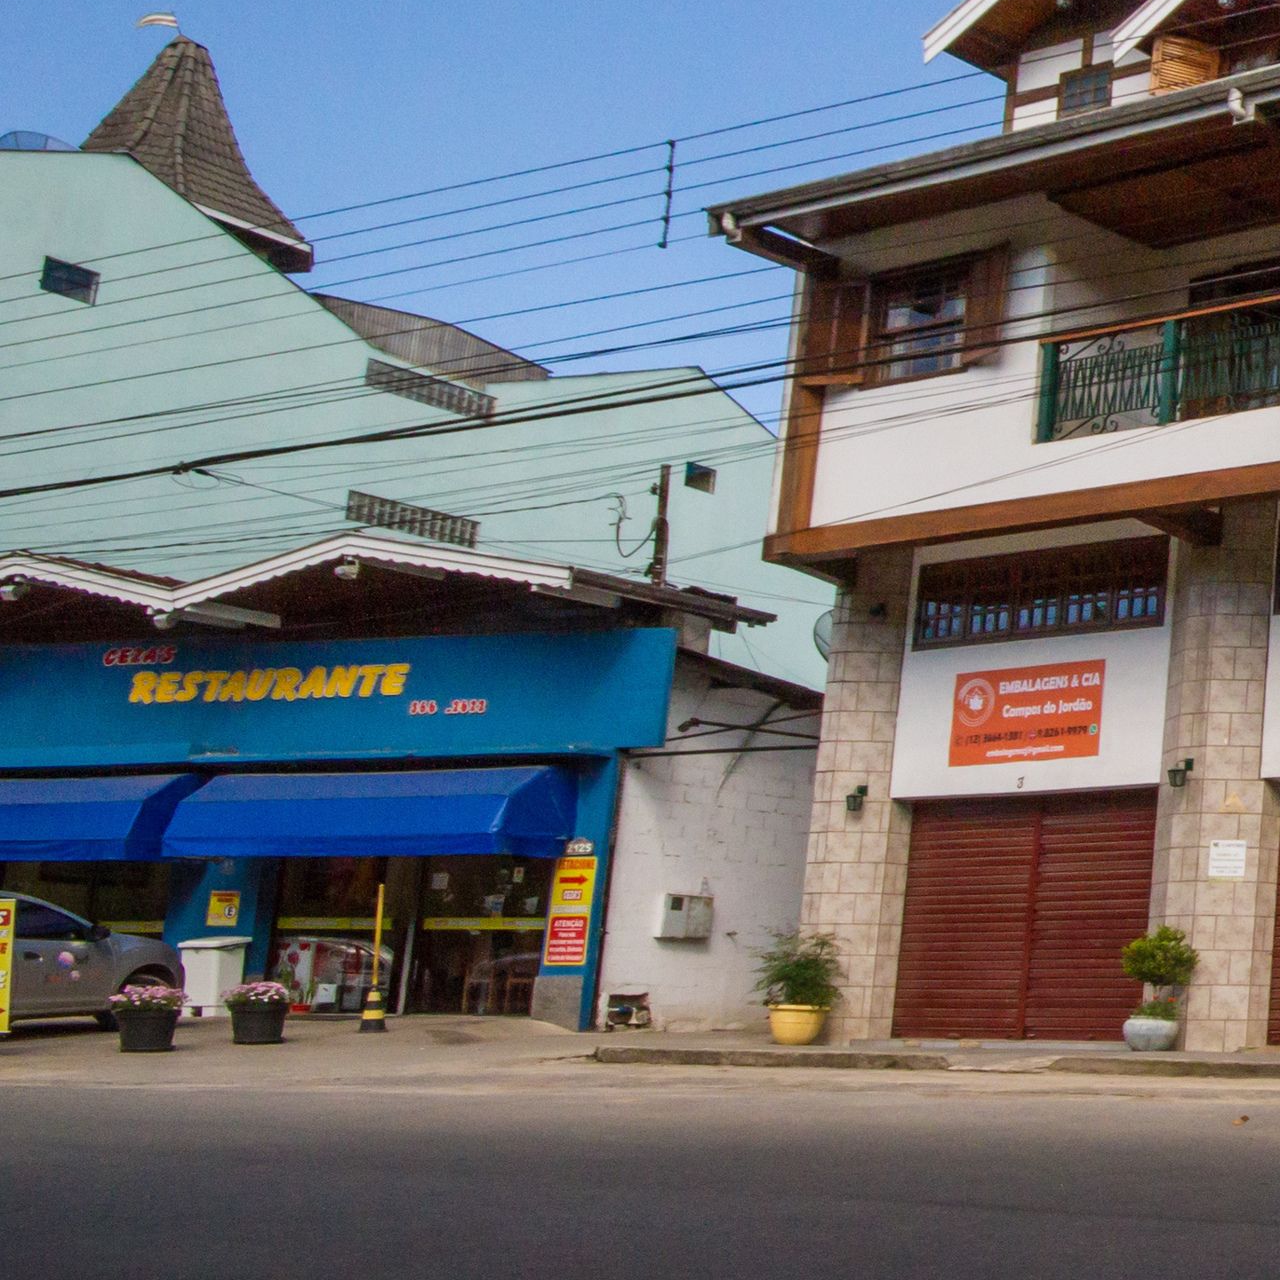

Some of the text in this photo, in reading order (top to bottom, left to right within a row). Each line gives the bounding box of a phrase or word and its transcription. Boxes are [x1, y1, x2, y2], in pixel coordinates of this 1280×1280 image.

[129, 663, 410, 704] RESTAURANTE
[999, 672, 1100, 695] EMBALAGENS & CIA
[1002, 698, 1093, 719] Campos do Jordão
